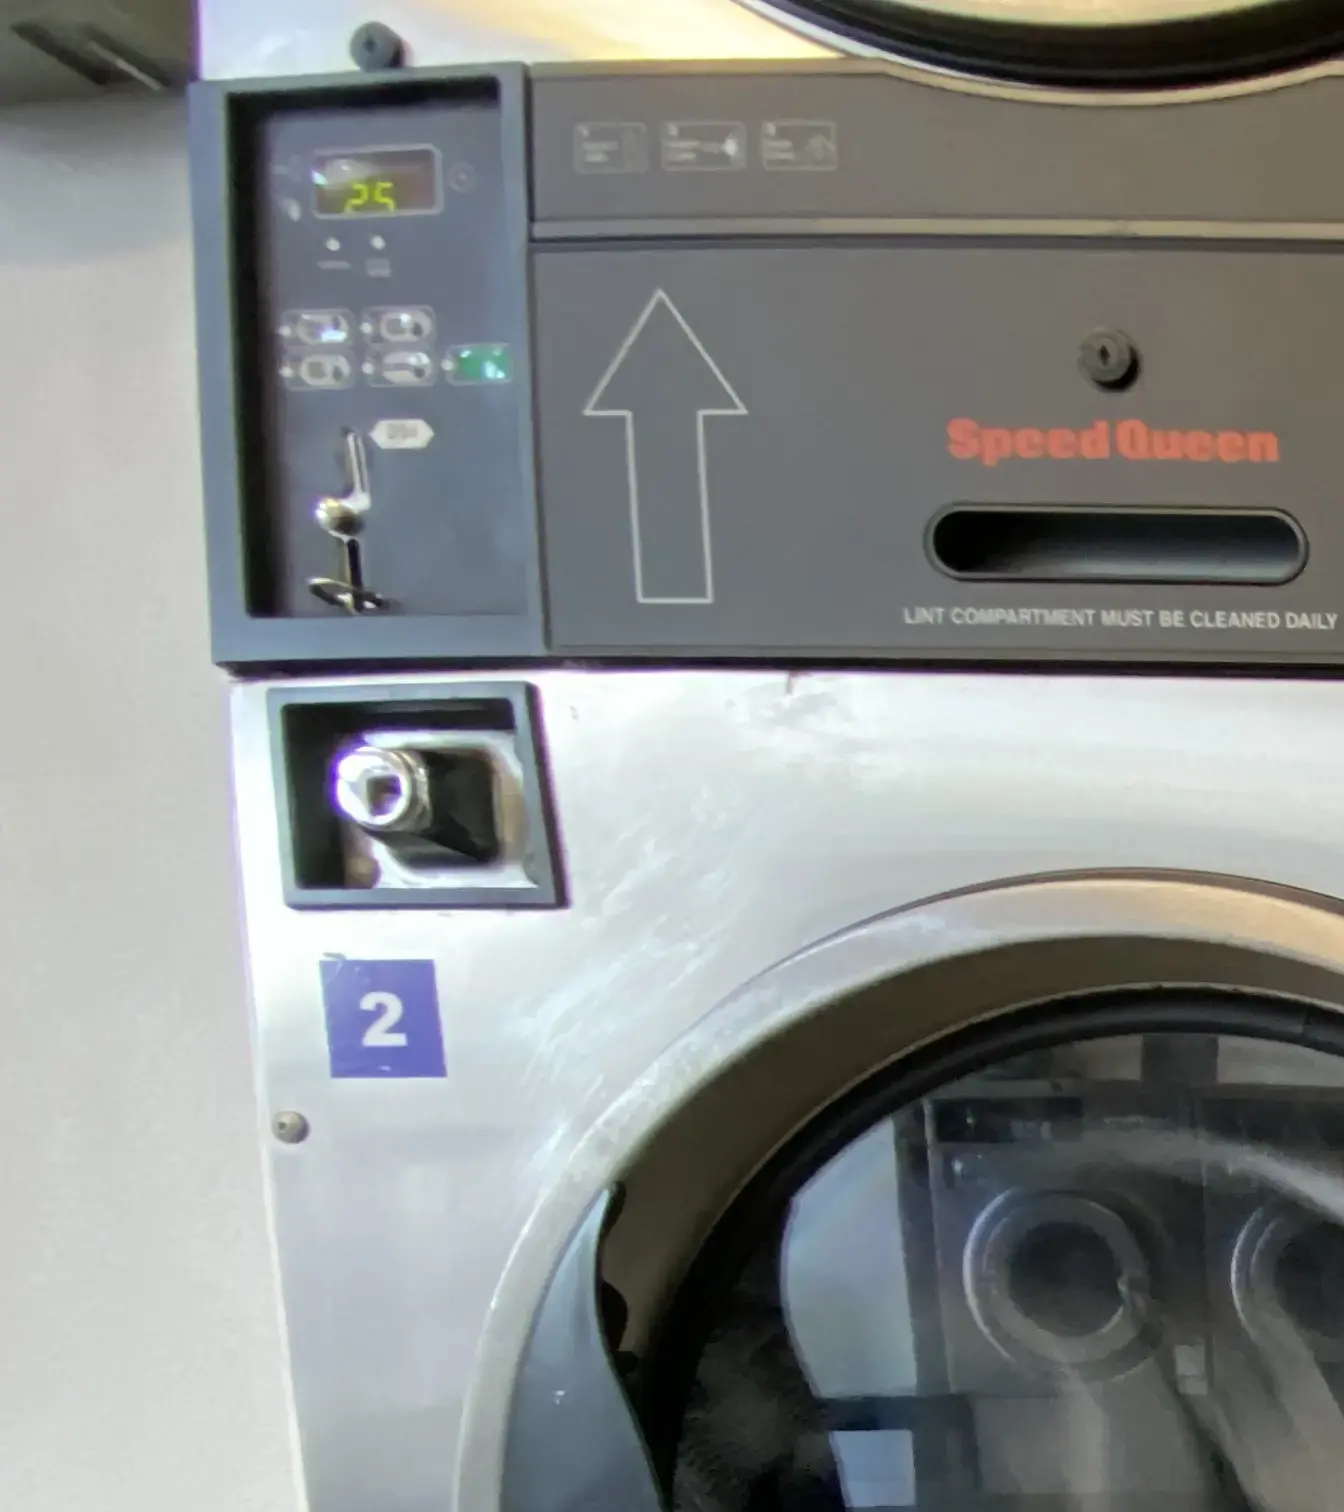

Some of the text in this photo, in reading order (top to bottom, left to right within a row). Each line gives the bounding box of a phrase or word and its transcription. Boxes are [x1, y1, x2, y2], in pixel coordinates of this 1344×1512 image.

[947, 418, 1279, 466] Speed Queen
[904, 607, 1338, 630] LINT COMPARTMENT MUST BE CLEANED DAILY
[361, 992, 406, 1046] 2
